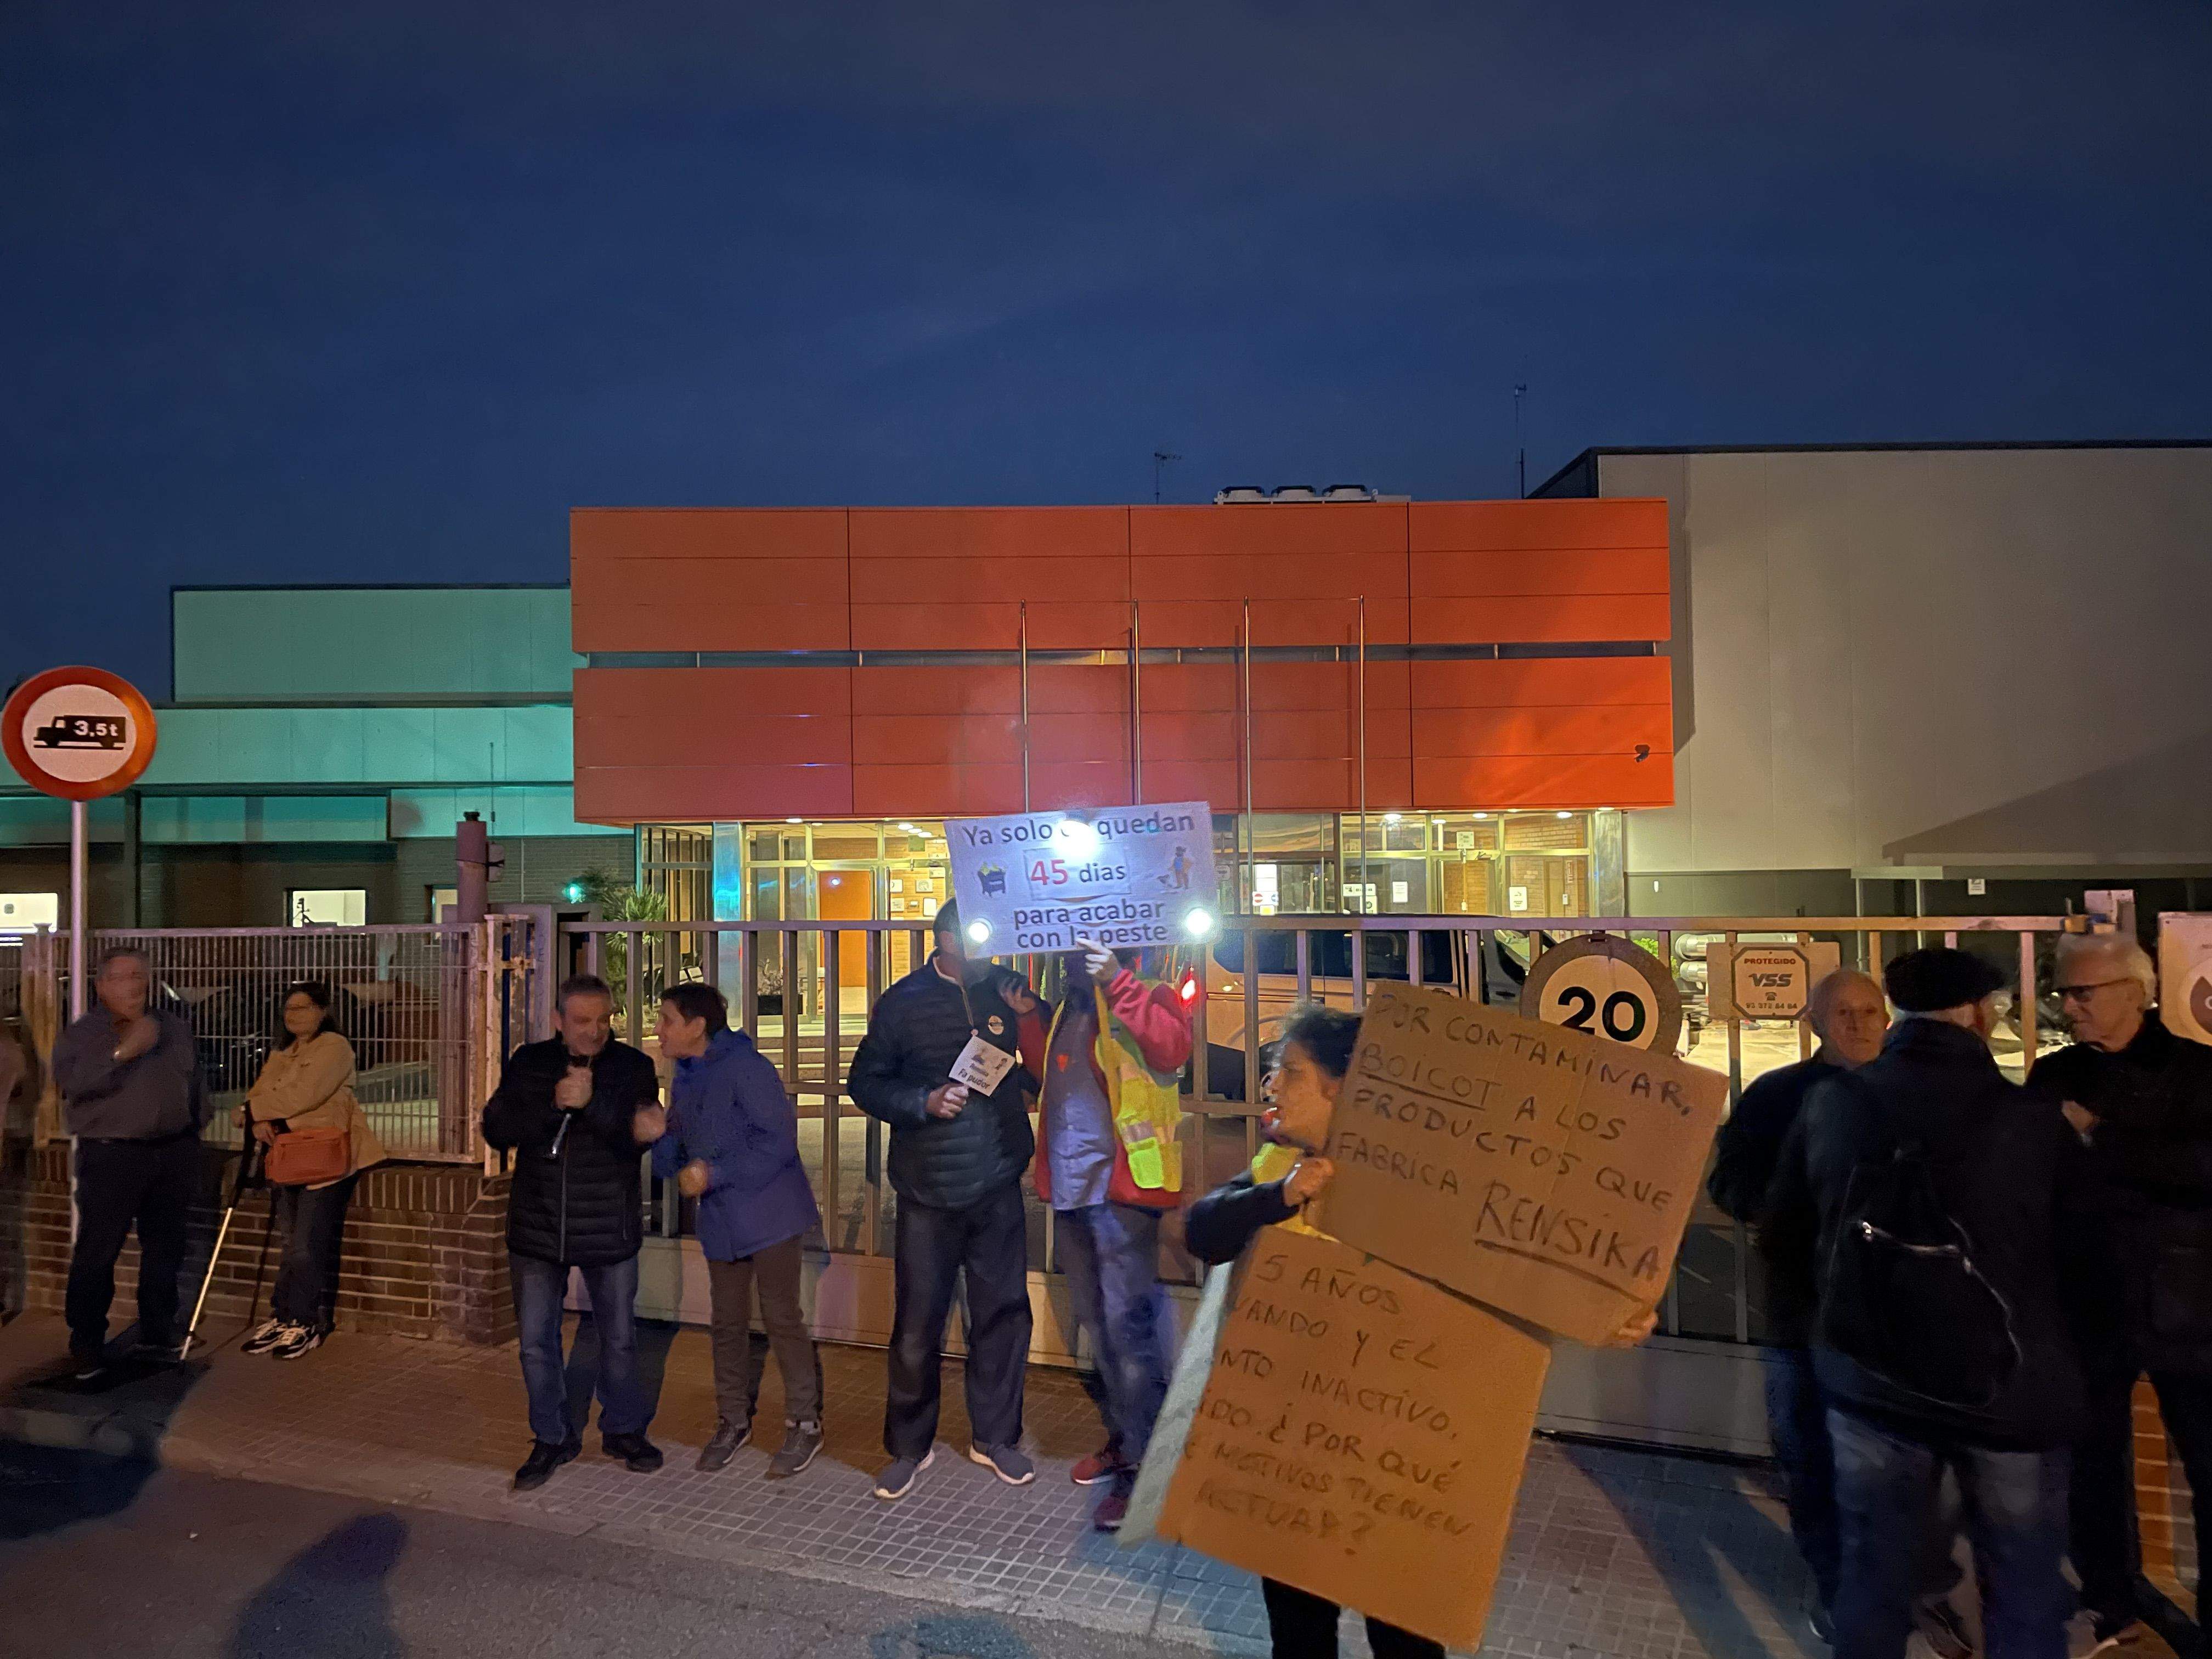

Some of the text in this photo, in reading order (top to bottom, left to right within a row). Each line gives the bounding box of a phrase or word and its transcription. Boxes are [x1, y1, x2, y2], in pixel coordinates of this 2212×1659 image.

[74, 720, 119, 737] 3.5t
[963, 823, 992, 847] Ya
[1002, 818, 1052, 843] solo
[1098, 810, 1194, 840] quedan
[1030, 859, 1069, 885] 45
[1013, 898, 1165, 930] para acabar
[1017, 928, 1062, 949] con
[1099, 924, 1167, 947] peste
[1748, 973, 1793, 987] VSS
[1376, 993, 1430, 1034] POR
[1557, 986, 1646, 1042] 20
[1359, 1042, 1627, 1140] BOICOT A LOS
[1353, 1088, 1673, 1211] PRODUCTOS QUE
[1336, 1131, 1659, 1280] FABRICA RENSIKA
[1256, 1254, 1401, 1315] 5 AÑOS
[1220, 1348, 1273, 1378] NTO
[1352, 1329, 1370, 1368] Y
[1390, 1339, 1439, 1370] EL
[1378, 1449, 1461, 1494] QUÉ
